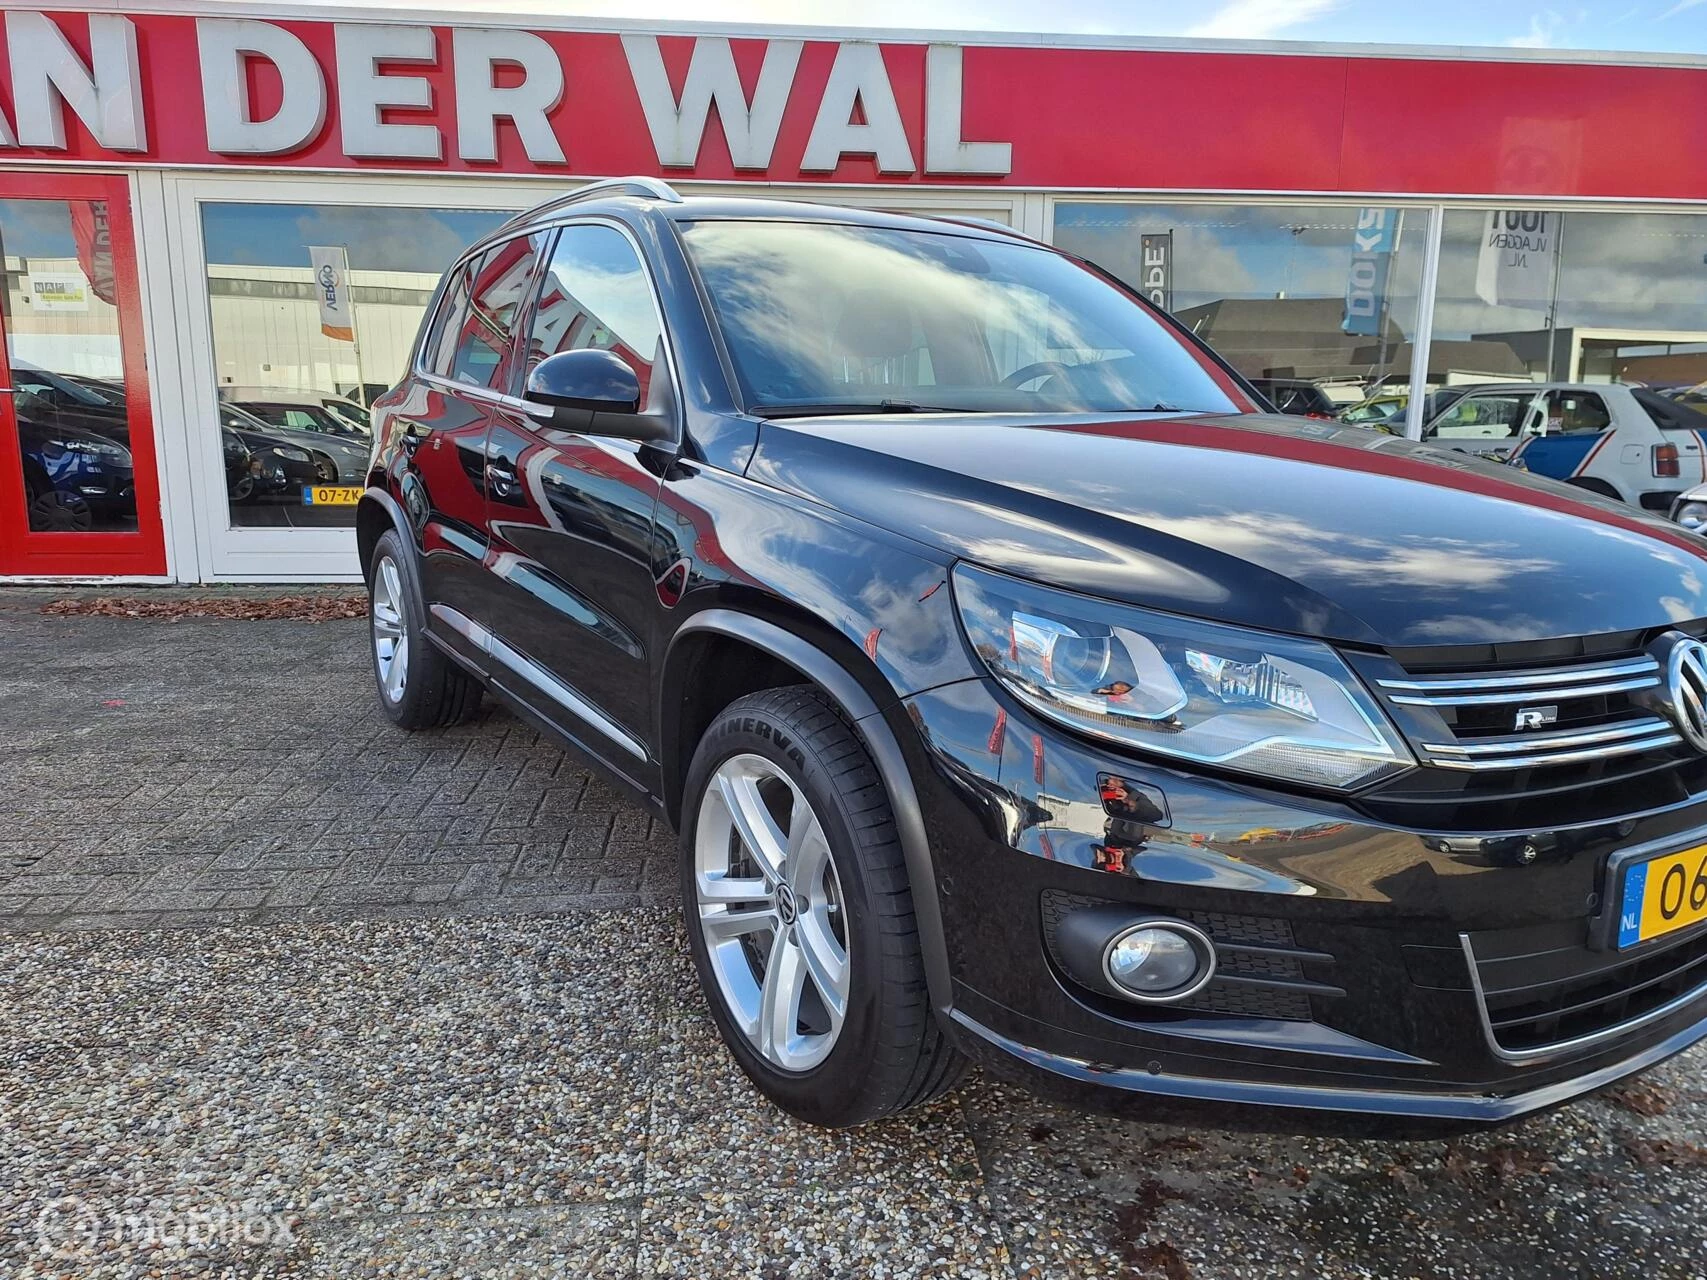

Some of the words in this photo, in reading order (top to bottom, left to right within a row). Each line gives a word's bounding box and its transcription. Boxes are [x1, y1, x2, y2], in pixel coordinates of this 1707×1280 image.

[0, 11, 147, 152] N
[195, 17, 568, 165] DER
[620, 34, 1013, 177] WAL
[1621, 912, 1638, 932] NL
